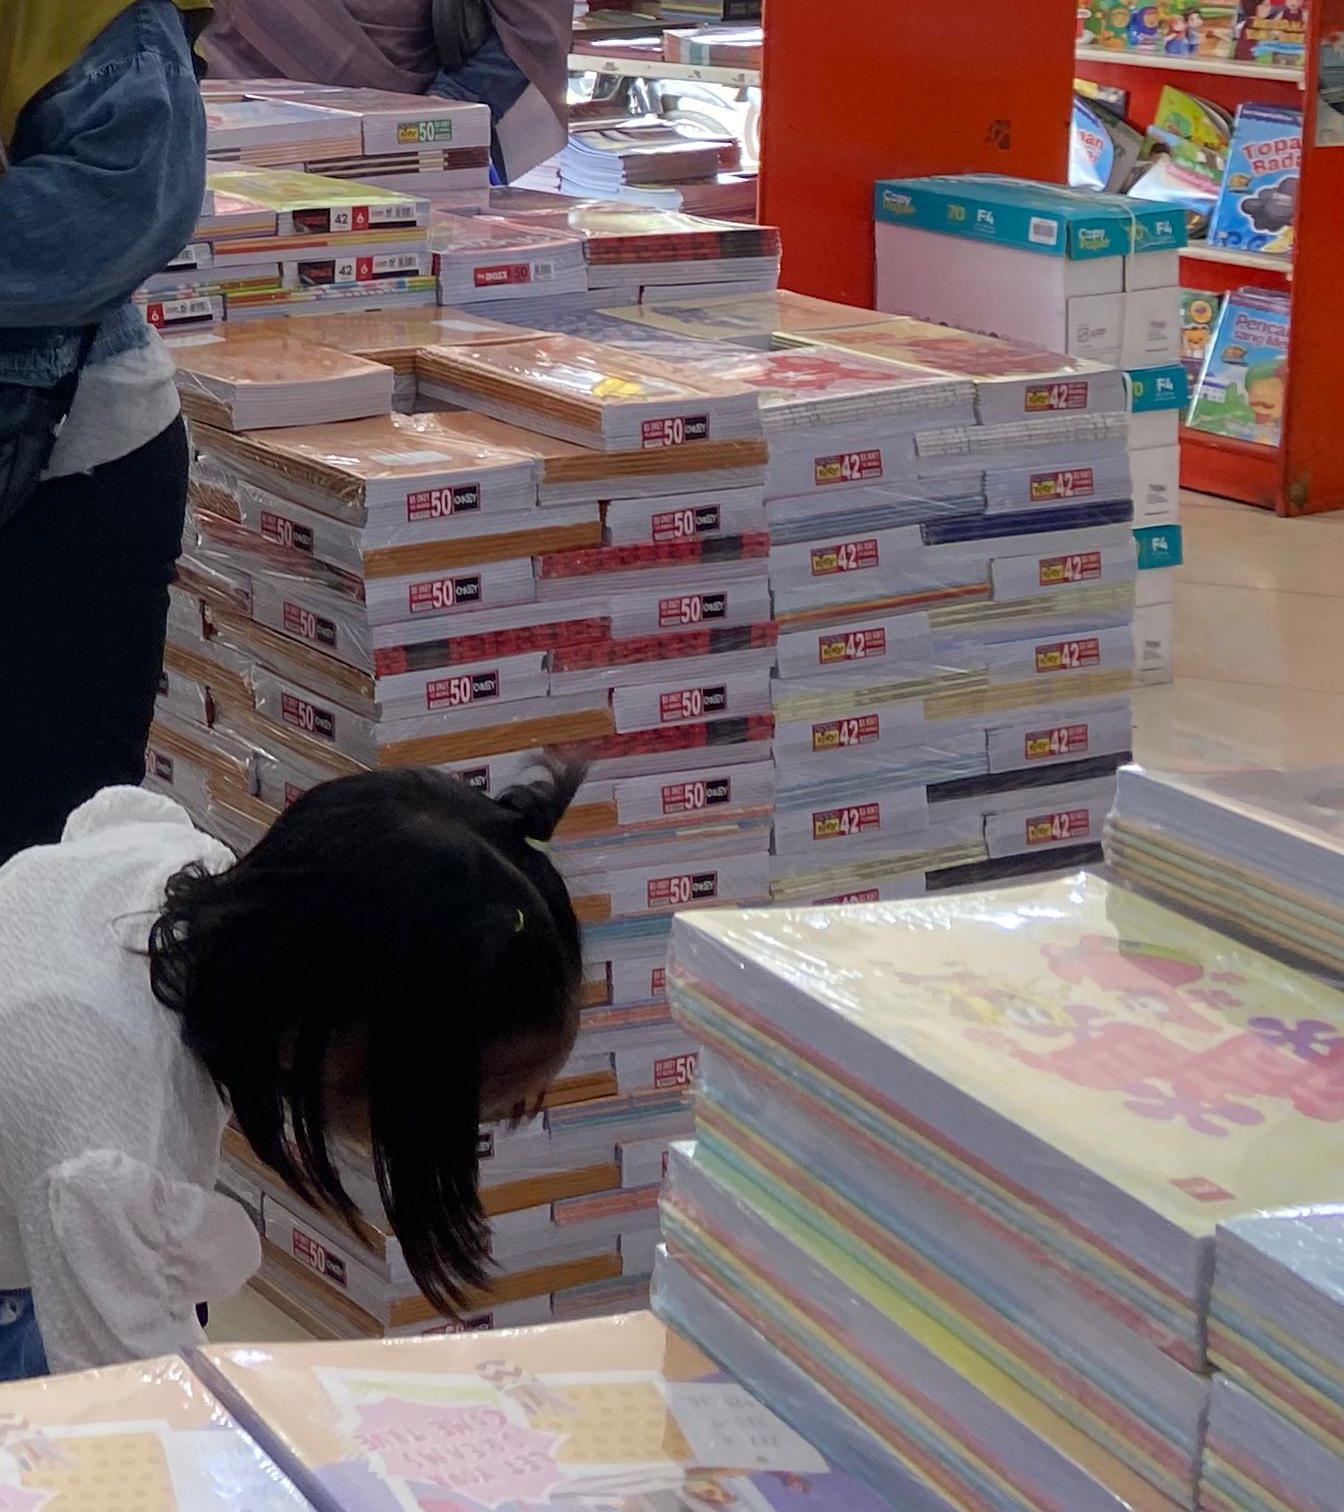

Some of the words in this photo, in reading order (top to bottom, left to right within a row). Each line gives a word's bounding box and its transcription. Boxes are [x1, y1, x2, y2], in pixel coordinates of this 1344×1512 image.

[419, 121, 435, 142] 50
[334, 213, 348, 225] 42
[356, 211, 365, 224] 6
[976, 208, 995, 225] F4
[1155, 221, 1173, 236] F4
[338, 264, 353, 276] 42
[360, 262, 369, 275] 6
[150, 310, 160, 322] 6
[1050, 384, 1068, 409] 42
[1156, 377, 1174, 392] F4
[664, 418, 683, 446] 50
[842, 453, 861, 480] 42
[1055, 472, 1074, 497] 42
[431, 489, 452, 517] 50
[276, 518, 293, 546] 50
[674, 510, 694, 537] 50
[838, 544, 858, 570] 42
[1150, 537, 1169, 553] F4
[1065, 557, 1081, 582] 42
[433, 580, 453, 608] 50
[681, 596, 701, 624] 50
[299, 611, 316, 638] 50
[846, 632, 865, 660] 42
[1062, 643, 1080, 668] 42
[450, 678, 471, 705] 50
[682, 689, 702, 717] 50
[297, 702, 313, 730] 50
[839, 718, 859, 746] 42
[1051, 729, 1069, 754] 42
[685, 784, 703, 813] 50
[840, 808, 860, 836] 42
[1052, 814, 1070, 839] 42
[669, 876, 691, 904] 50
[309, 1241, 326, 1274] 50
[429, 1406, 508, 1438] COME
